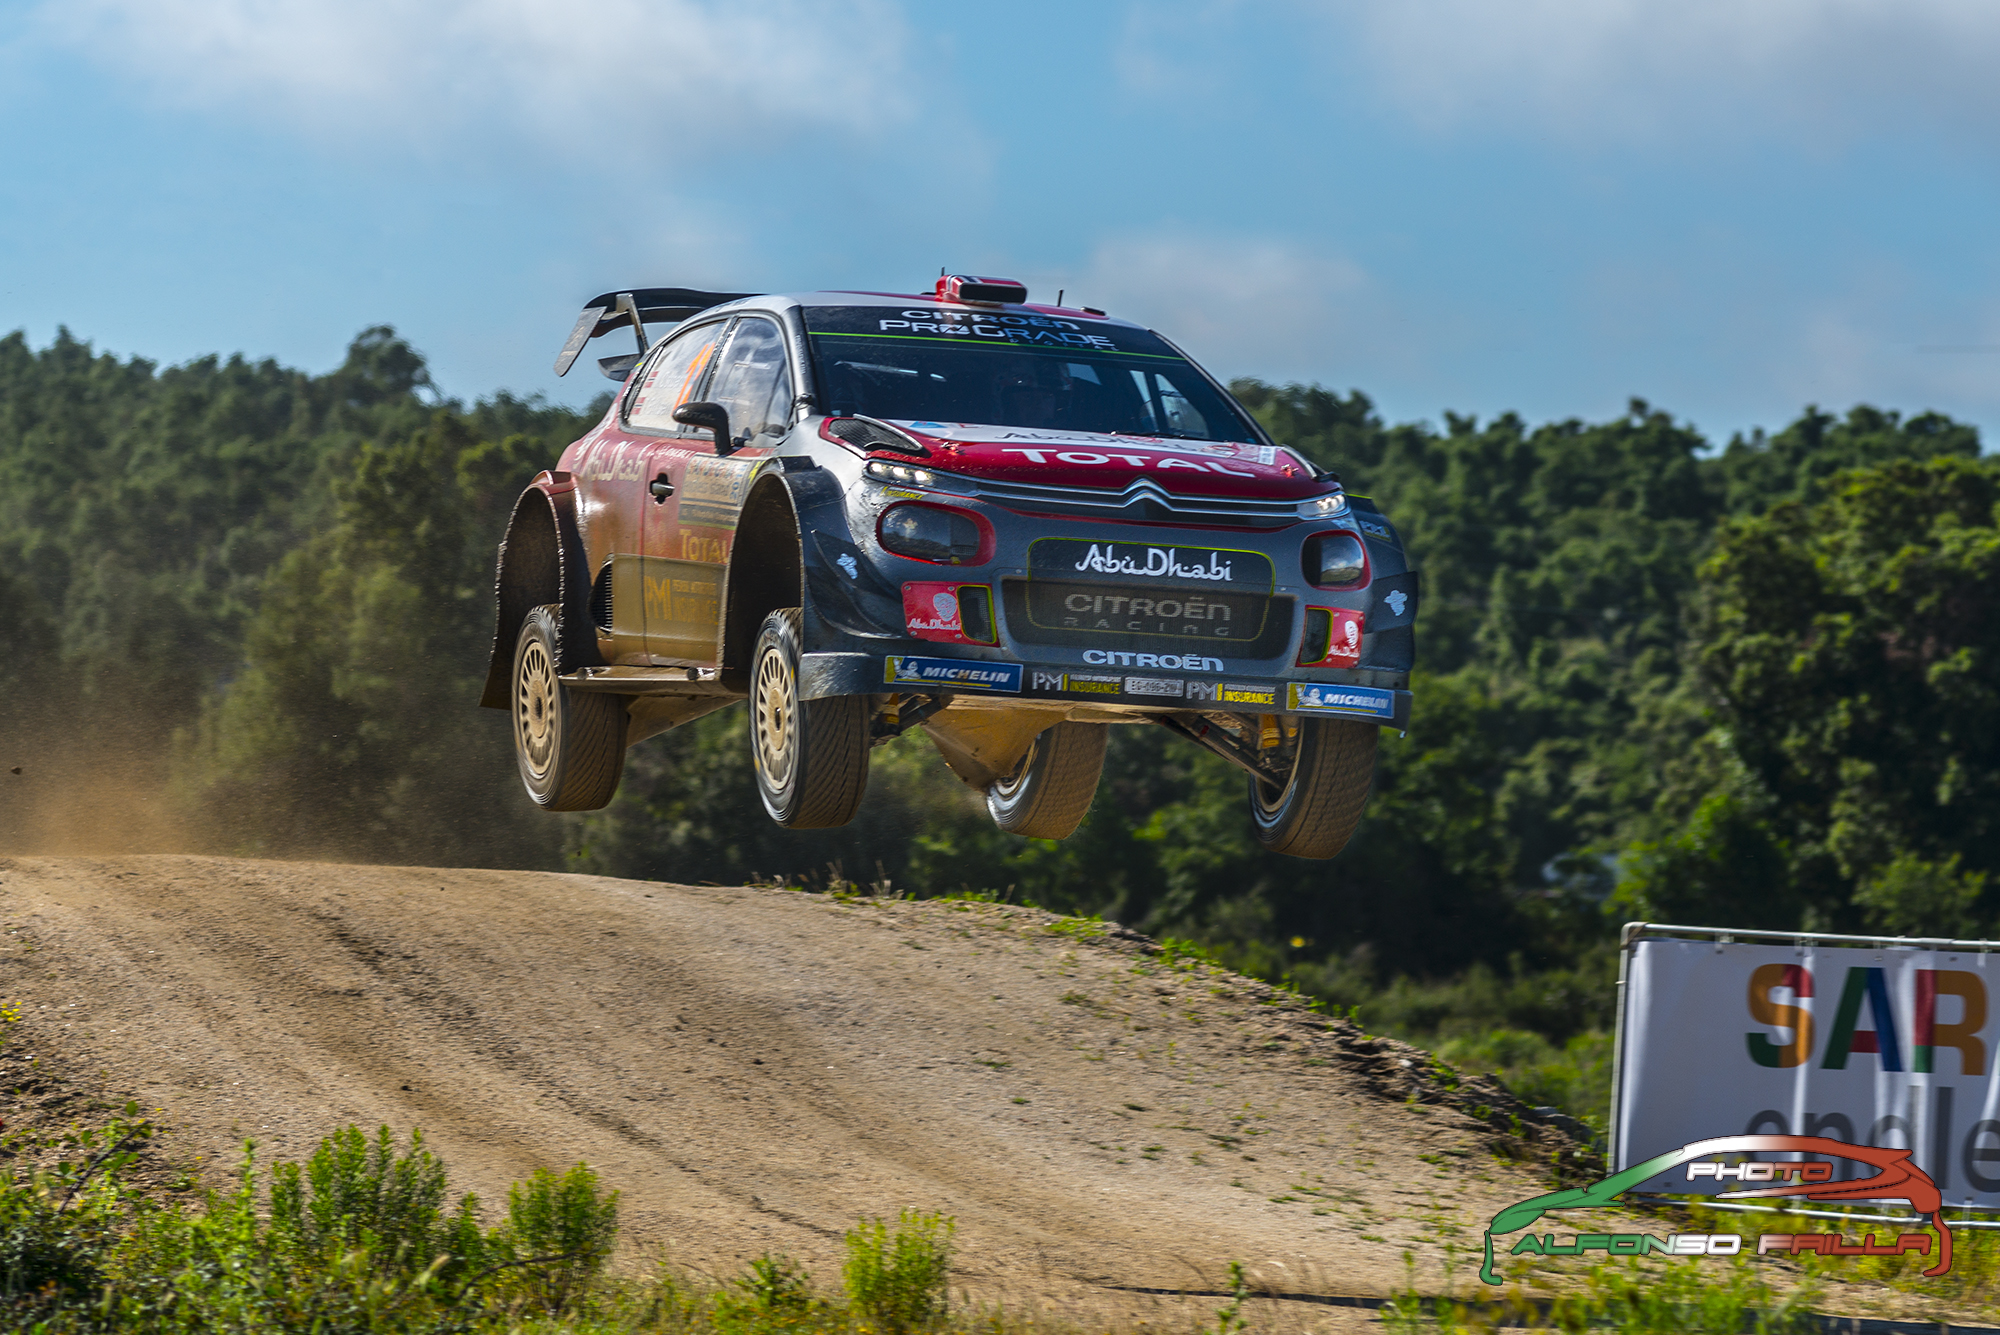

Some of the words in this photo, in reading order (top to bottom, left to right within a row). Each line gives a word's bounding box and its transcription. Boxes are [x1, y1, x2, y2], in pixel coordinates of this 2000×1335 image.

[900, 309, 1081, 330] CITROËN
[1001, 448, 1256, 478] TOTAL
[1064, 593, 1232, 621] CITROËN
[1063, 616, 1231, 637] RACING
[1082, 649, 1225, 672] CITROËN
[922, 667, 1011, 683] MICHELIN
[1069, 681, 1120, 694] INSURANCE
[1223, 691, 1276, 705] INSURANCE
[1323, 693, 1390, 709] MICHELIN
